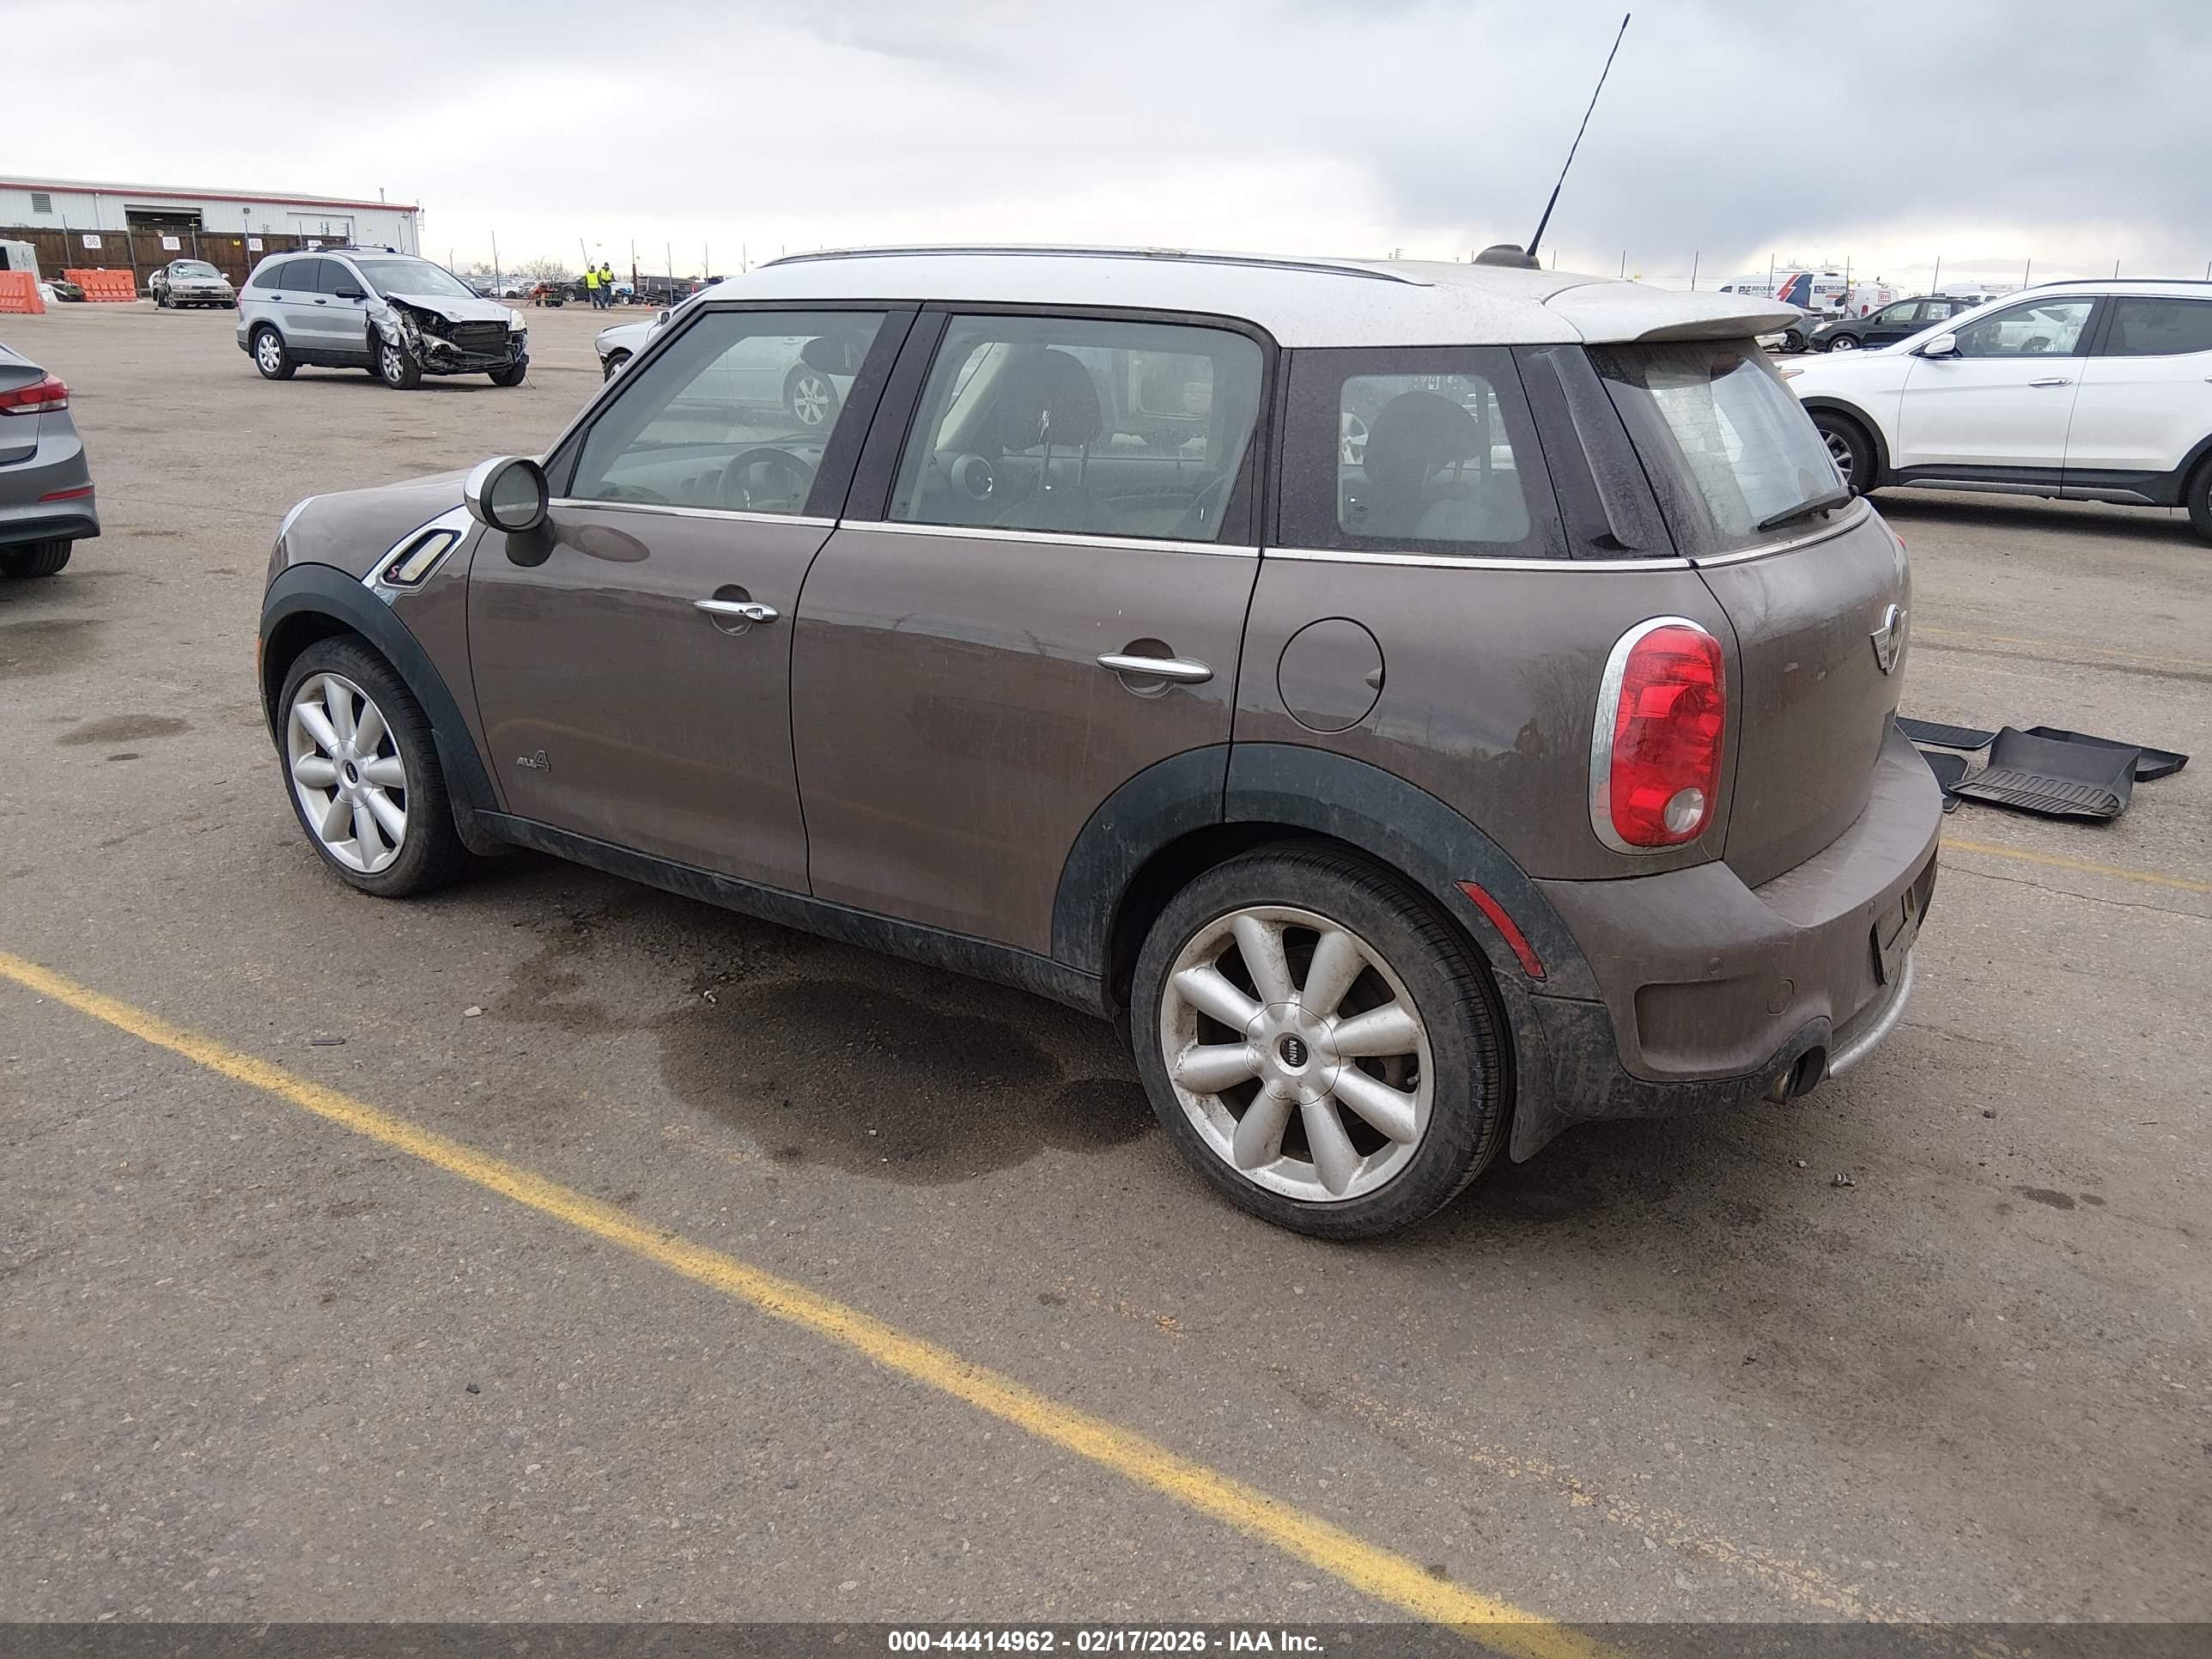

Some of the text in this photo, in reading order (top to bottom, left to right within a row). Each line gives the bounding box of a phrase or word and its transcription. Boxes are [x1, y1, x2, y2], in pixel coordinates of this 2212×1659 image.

[85, 236, 99, 246] 36
[165, 239, 178, 247] 38
[250, 240, 260, 249] 40
[389, 564, 400, 579] S
[1289, 1040, 1297, 1065] MINI
